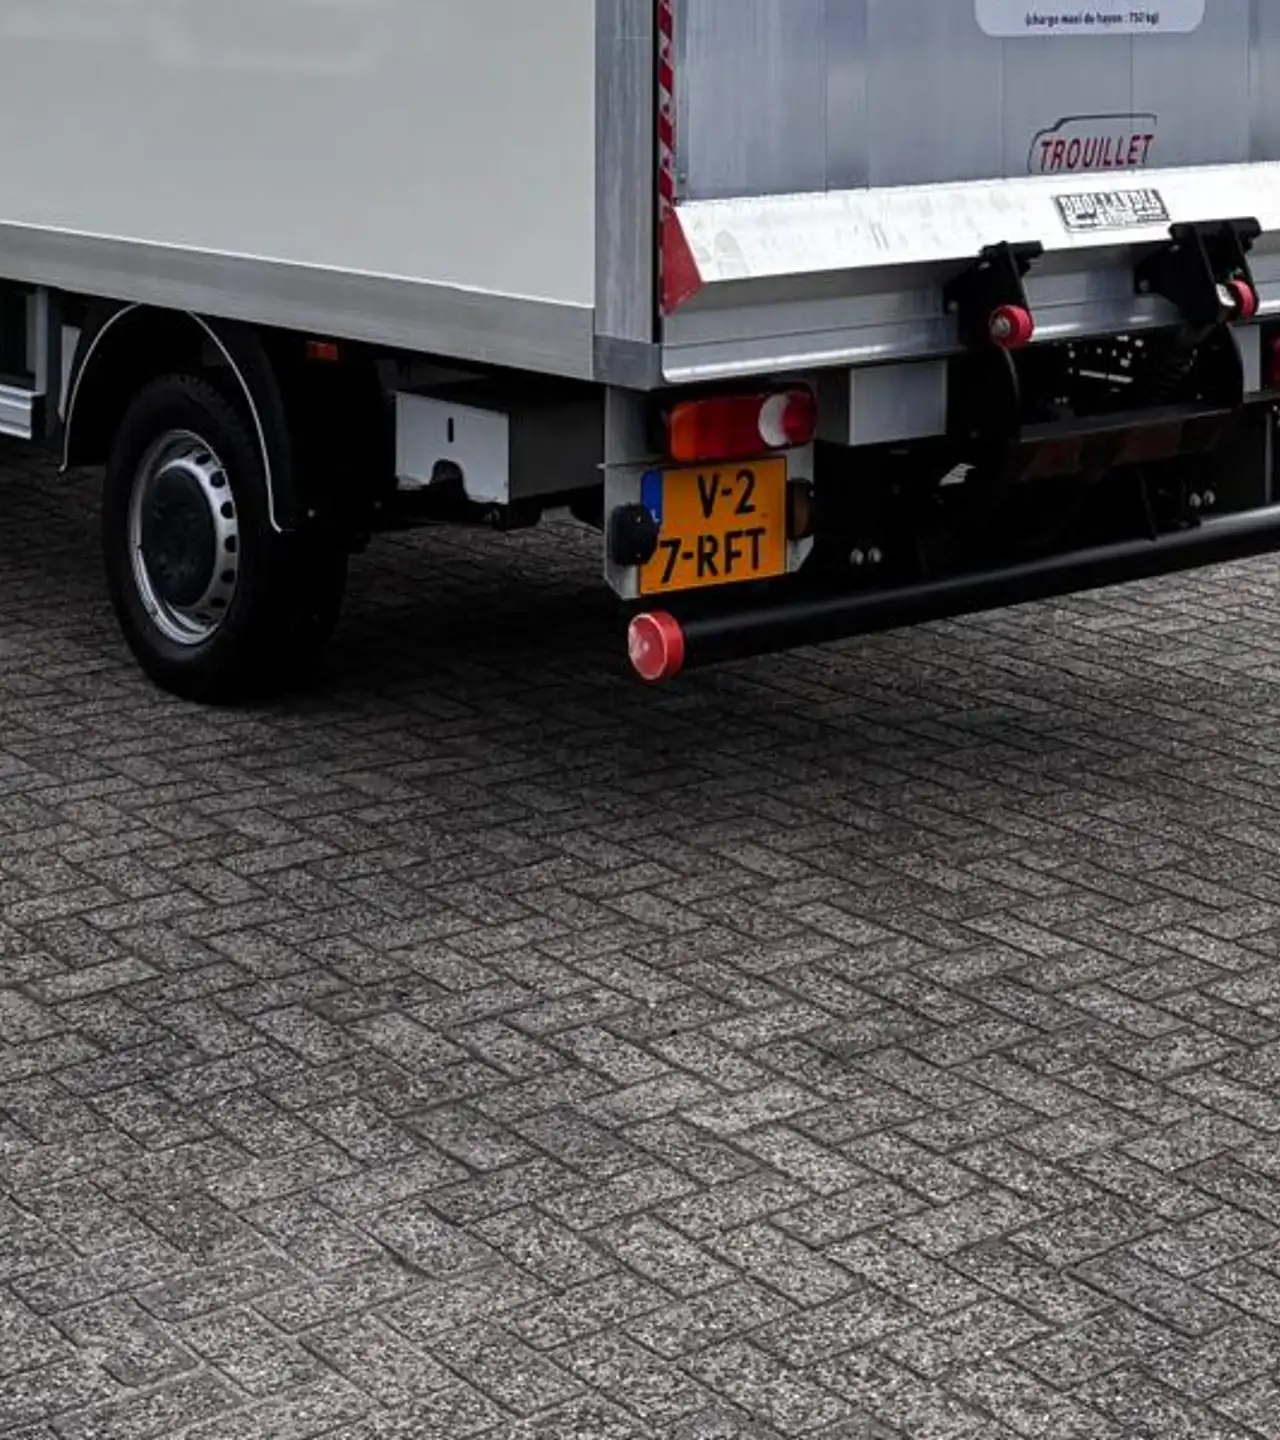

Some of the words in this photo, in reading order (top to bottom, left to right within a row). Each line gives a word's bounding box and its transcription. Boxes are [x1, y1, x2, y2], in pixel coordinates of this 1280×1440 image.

[1039, 134, 1154, 173] TROUILLET
[696, 468, 756, 520] V-2
[658, 526, 766, 585] 7-RFT
